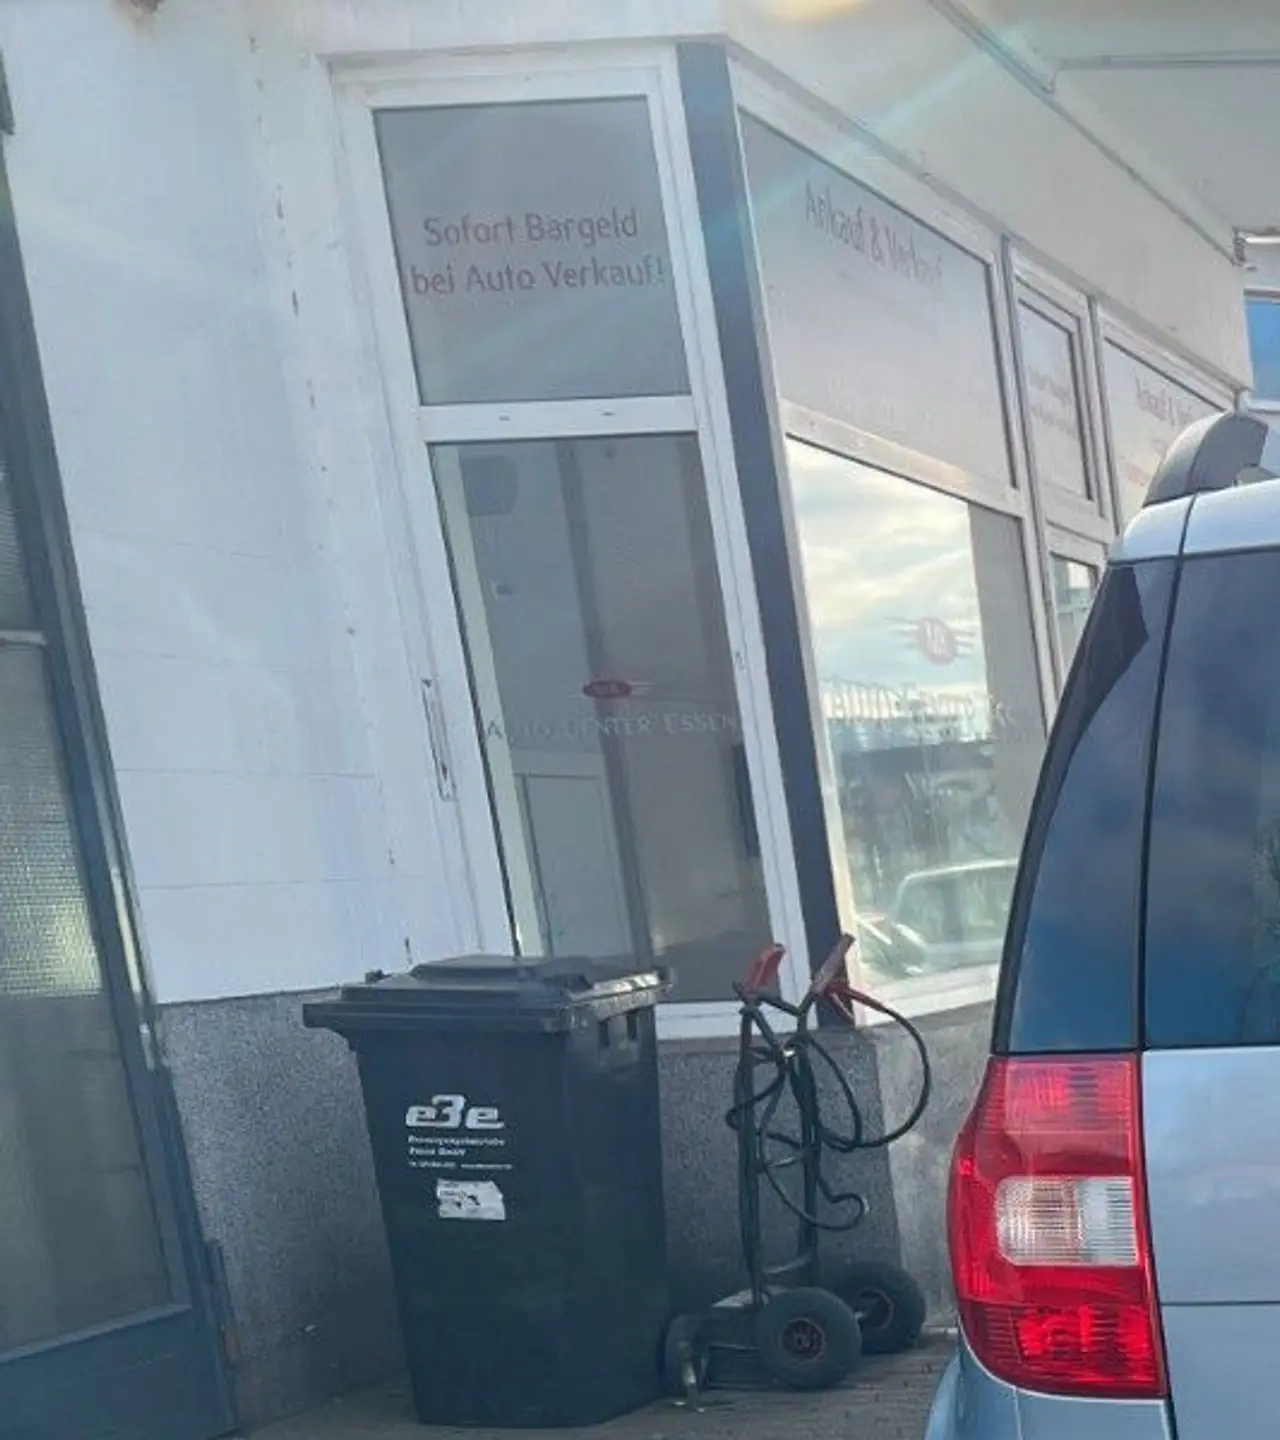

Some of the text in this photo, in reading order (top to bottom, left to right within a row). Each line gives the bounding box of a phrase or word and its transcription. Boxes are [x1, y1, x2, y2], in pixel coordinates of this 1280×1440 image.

[423, 207, 637, 250] Sofort Bargeld
[410, 254, 666, 295] bei Auto Verkauf!
[405, 1094, 505, 1129] e3e
